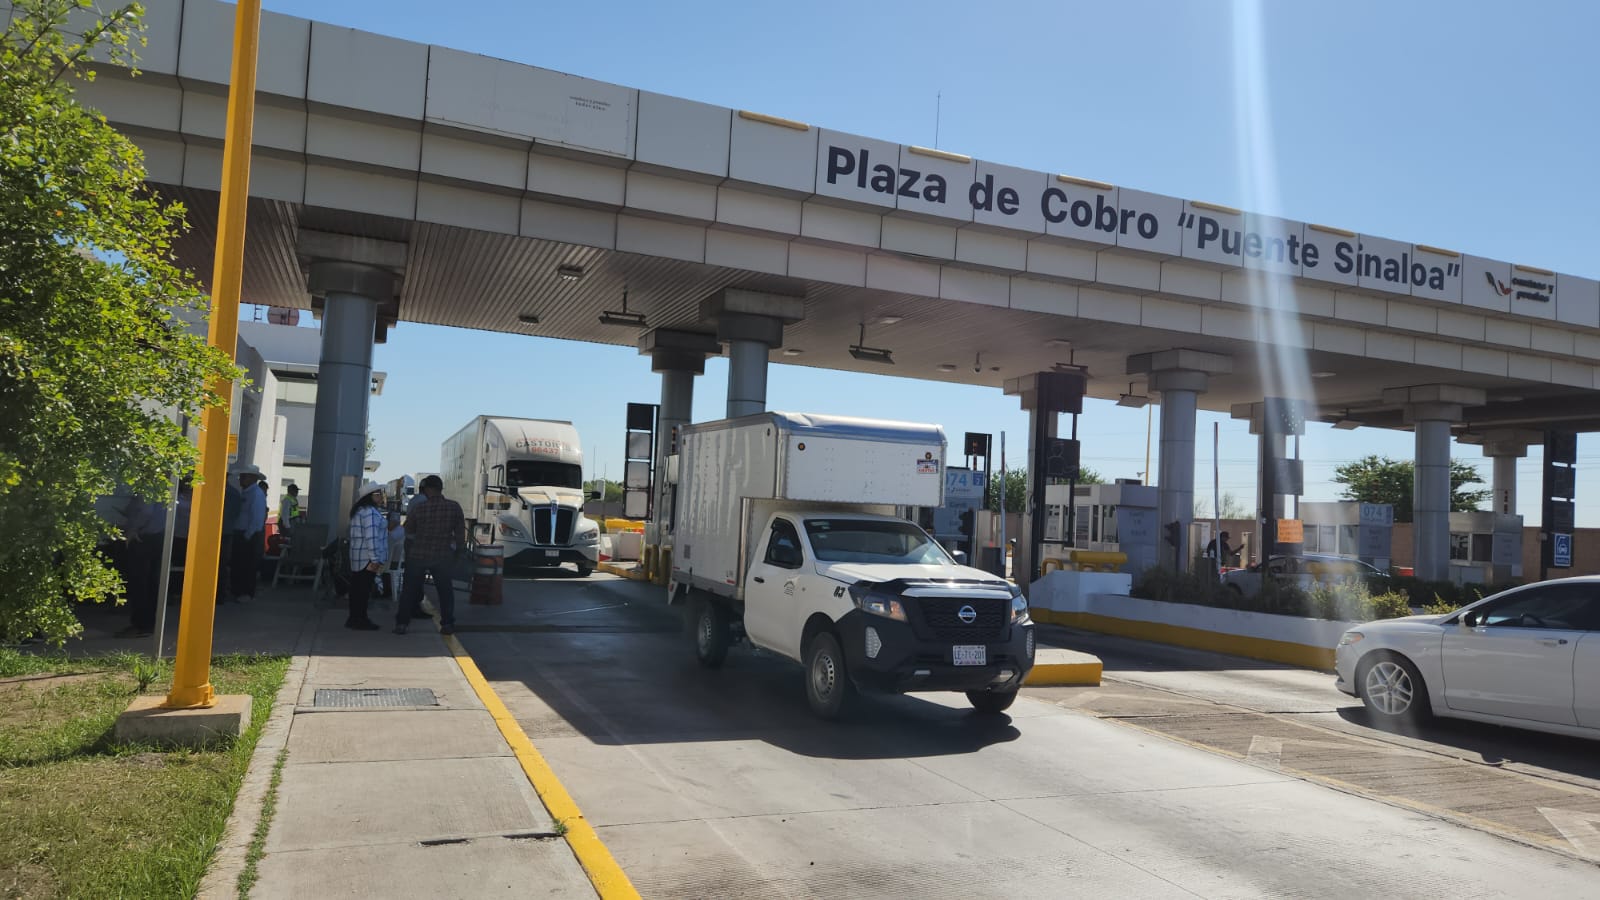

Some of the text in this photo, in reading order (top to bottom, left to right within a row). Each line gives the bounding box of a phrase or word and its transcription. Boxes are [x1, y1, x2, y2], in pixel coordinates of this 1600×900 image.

[827, 146, 947, 204] Plaza
[969, 175, 1020, 216] de
[1041, 187, 1158, 240] Cobro
[1363, 505, 1382, 517] 074
